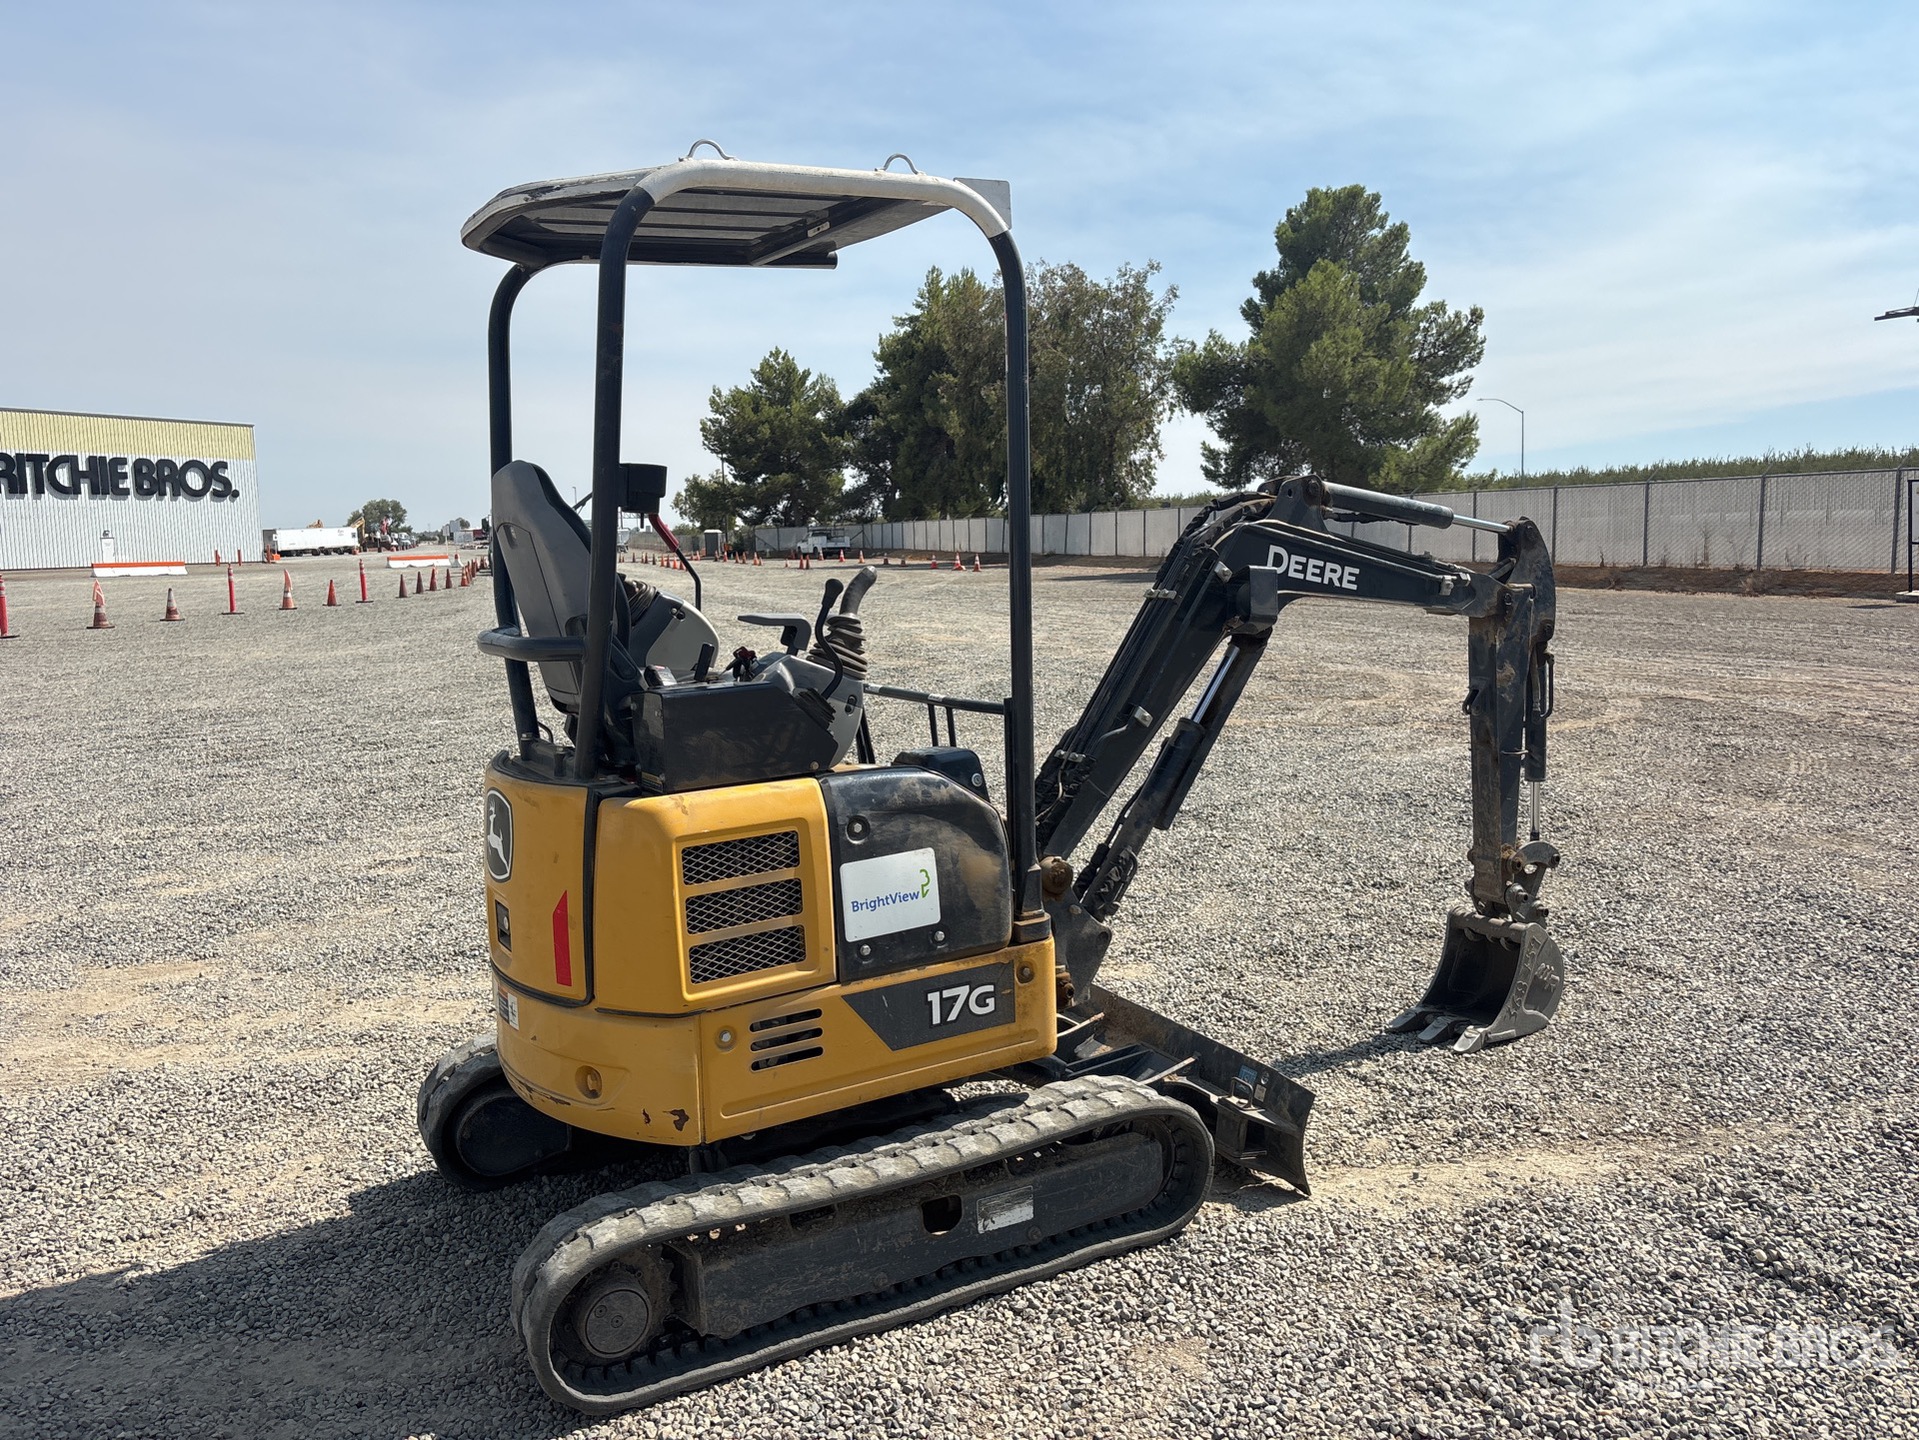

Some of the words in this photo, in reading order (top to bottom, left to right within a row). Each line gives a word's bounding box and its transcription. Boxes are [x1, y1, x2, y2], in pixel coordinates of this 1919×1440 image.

[0, 452, 130, 496] RITCHIE
[133, 458, 240, 499] BROS.
[1267, 544, 1360, 590] DEERE
[851, 890, 920, 912] BrightView
[927, 984, 995, 1025] 17G
